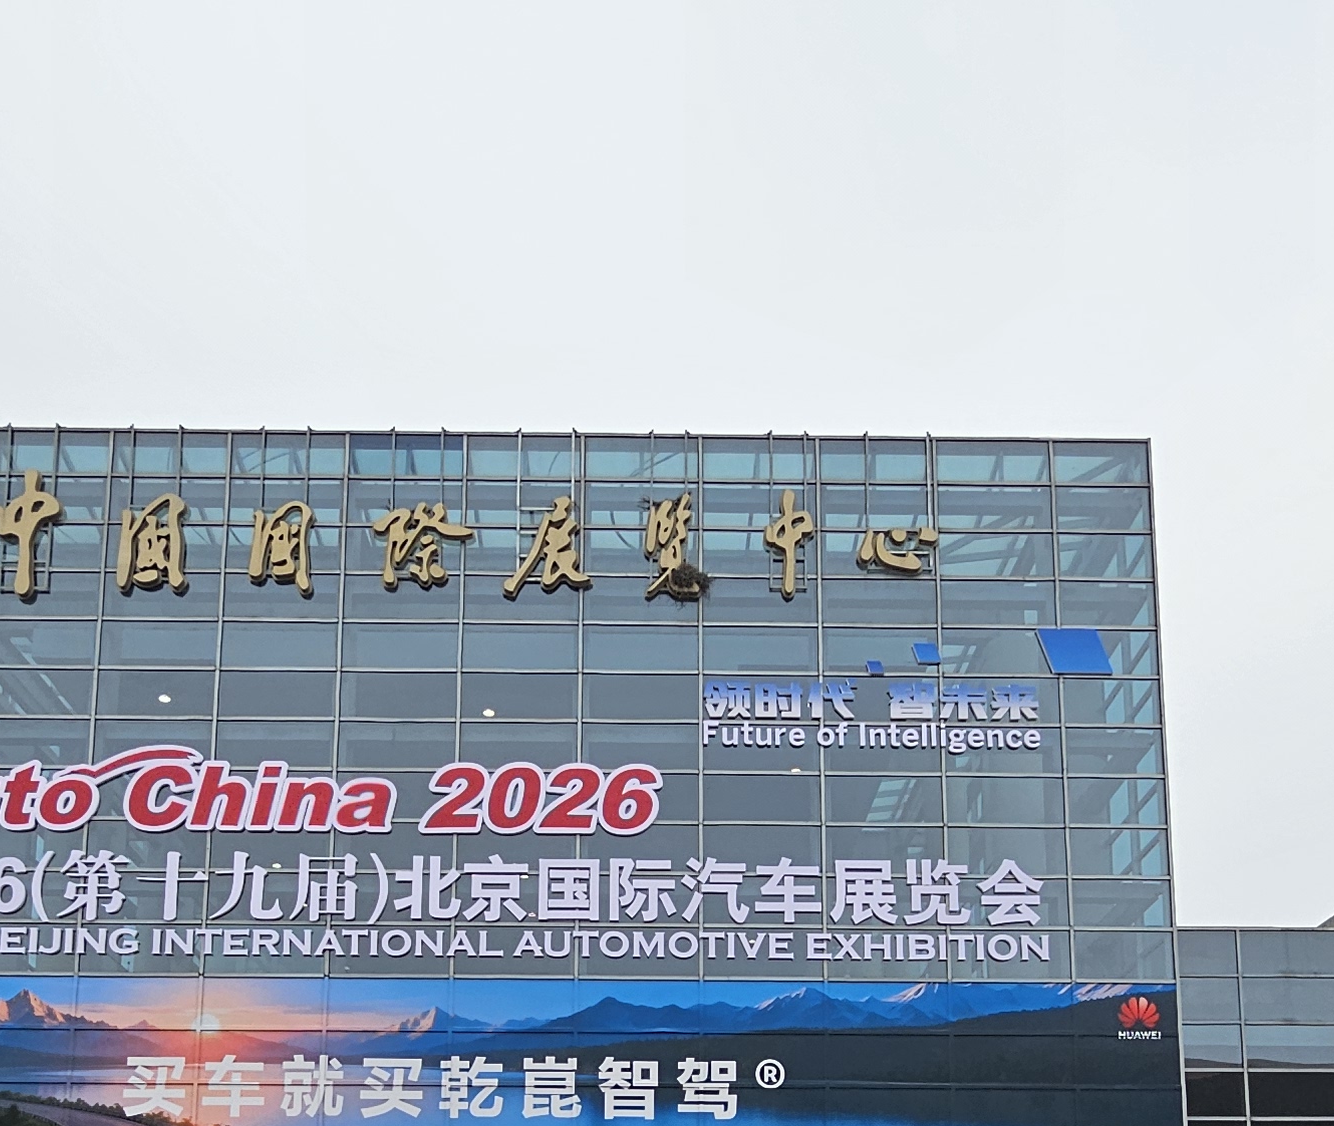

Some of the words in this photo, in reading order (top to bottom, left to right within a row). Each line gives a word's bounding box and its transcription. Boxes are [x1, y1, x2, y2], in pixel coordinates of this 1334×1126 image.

[703, 681, 856, 720] 领时代
[888, 683, 1039, 722] 智未来
[702, 722, 806, 748] Future
[817, 723, 849, 748] of
[859, 723, 1042, 754] Intelligence
[124, 753, 397, 834] China
[418, 761, 663, 836] 2026
[151, 927, 489, 958] INTERNATIONAL
[512, 930, 796, 960] AUTOMOTIVE
[806, 932, 1051, 962] EXHIBITION
[1118, 1031, 1161, 1040] HUAWEI
